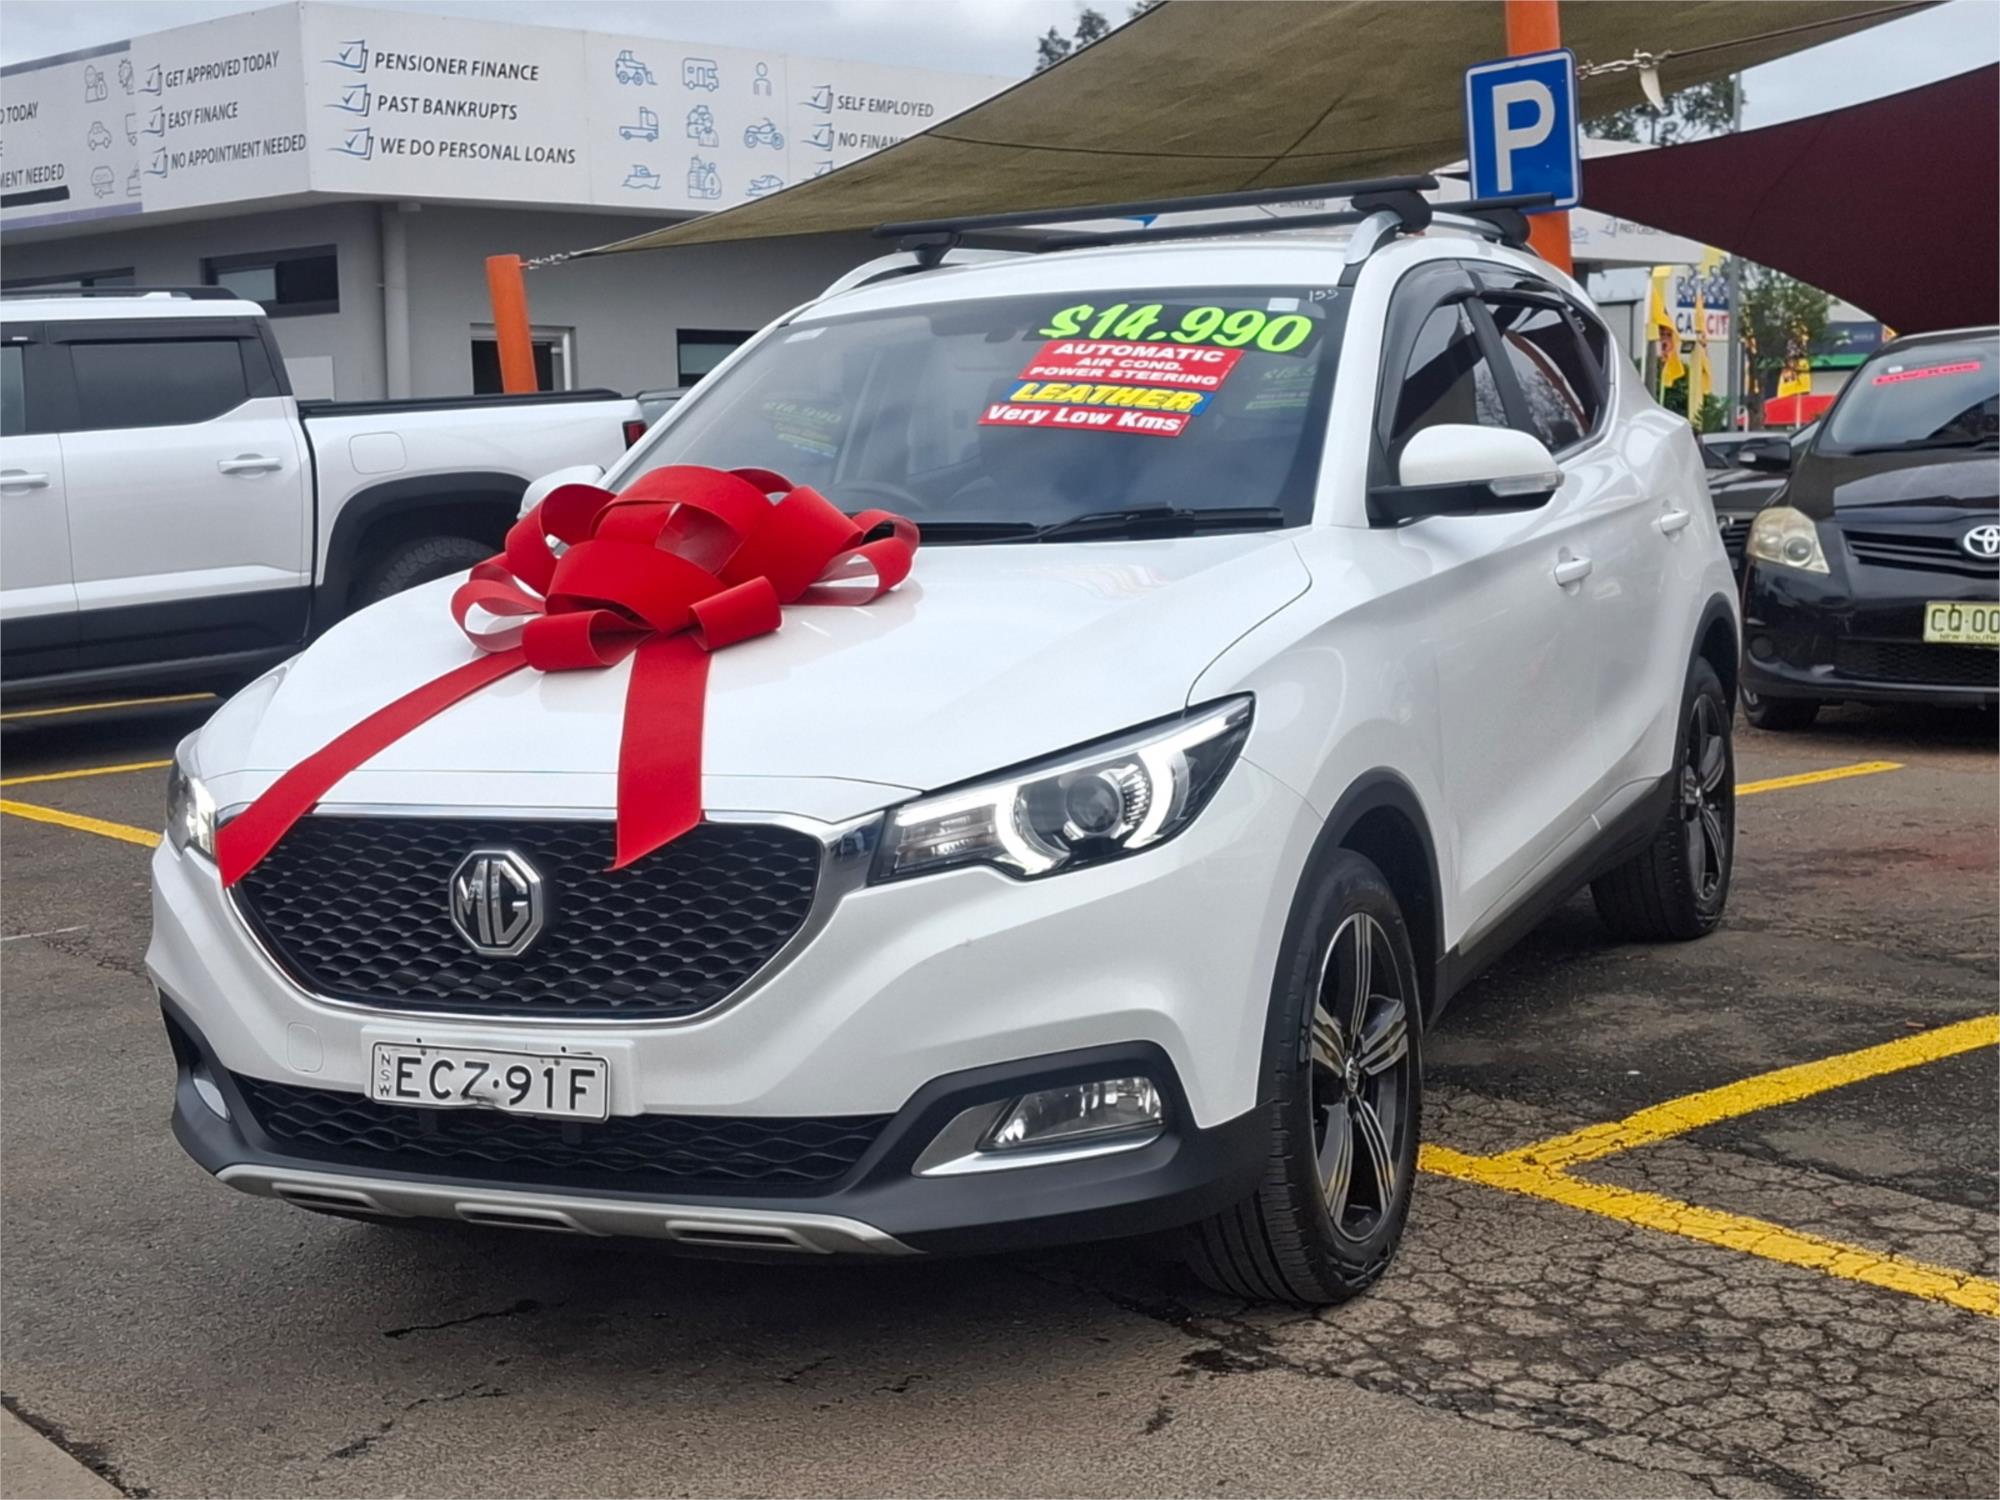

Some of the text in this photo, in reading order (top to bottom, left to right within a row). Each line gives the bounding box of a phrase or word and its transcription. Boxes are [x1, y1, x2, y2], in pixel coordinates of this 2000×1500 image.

[166, 51, 279, 88] GET APPROVED TODAY
[375, 52, 539, 81] PENSIONER FINANCE
[7, 101, 38, 123] TODAY
[168, 102, 238, 129] EASY FINANCE
[378, 95, 517, 120] PAST BANKRUPTS
[838, 95, 934, 117] SELF EMPLOYED
[839, 132, 857, 147] NO
[1492, 79, 1556, 192] P
[171, 134, 306, 169] NO APPOINTMENT NEEDED
[381, 138, 576, 164] WE DO PERSONAL LOANS
[26, 163, 64, 184] NEEDED
[1039, 304, 1312, 352] $14.990
[1053, 342, 1225, 363] AUTOMATIC
[1076, 357, 1184, 371] AIR COND.
[1030, 366, 1219, 386] POWER STEERING
[1010, 383, 1204, 411] LEATHER
[988, 405, 1182, 431] Very Low Kms
[456, 859, 529, 945] MG
